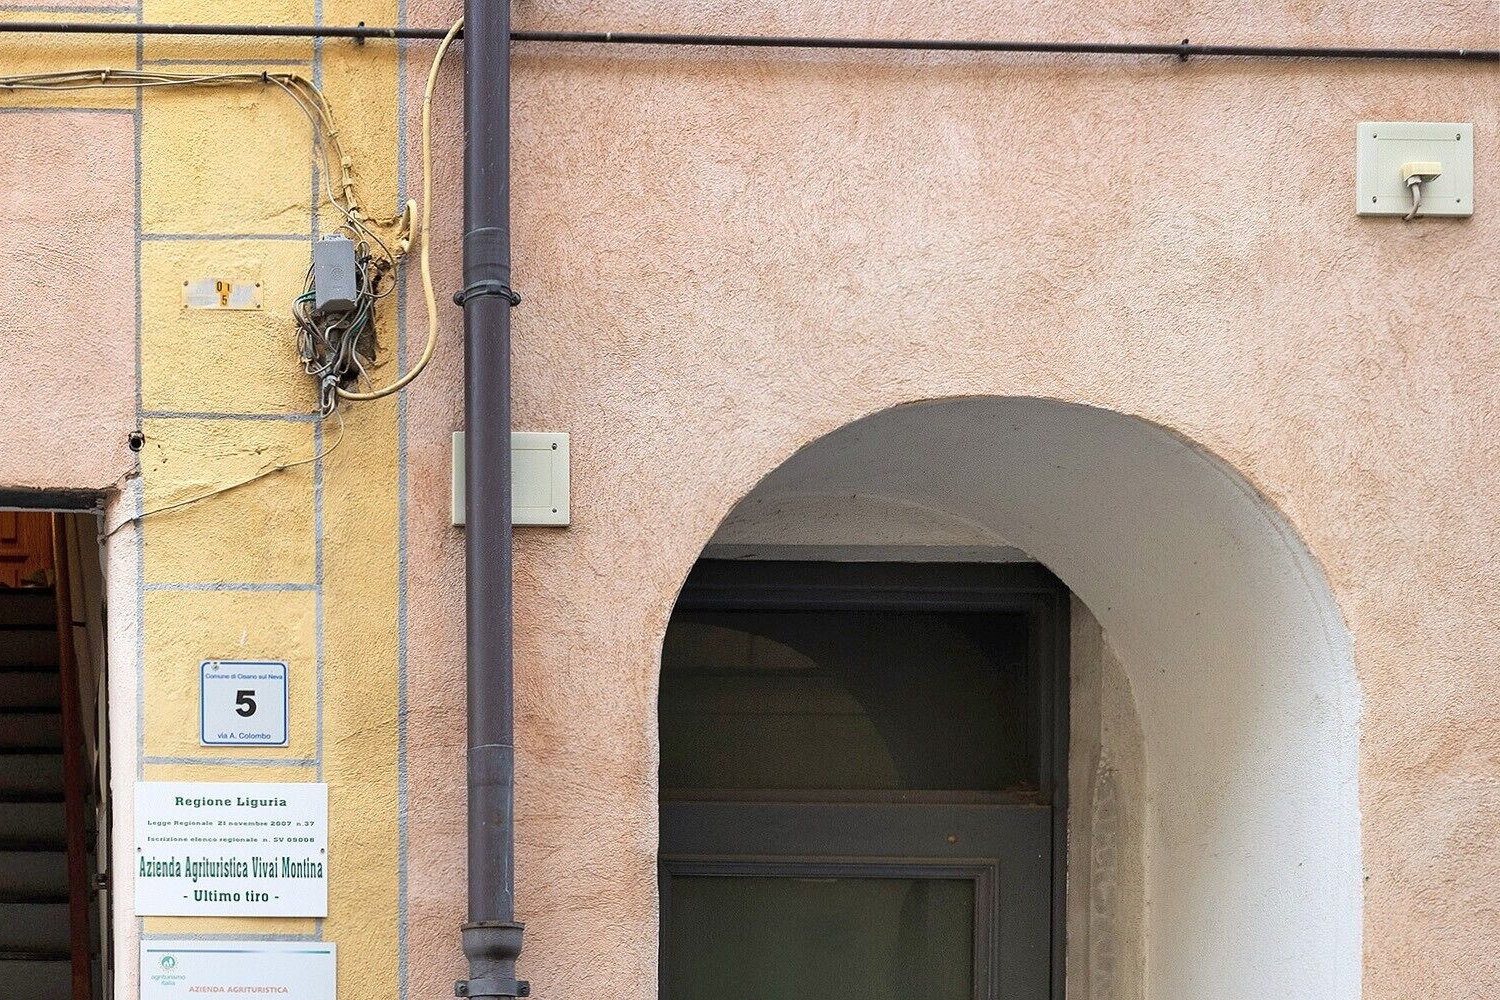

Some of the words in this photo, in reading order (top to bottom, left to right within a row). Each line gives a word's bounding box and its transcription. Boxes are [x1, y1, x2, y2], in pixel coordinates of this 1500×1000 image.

[235, 689, 257, 718] 5
[175, 796, 232, 808] Regione
[236, 797, 287, 809] Liguria
[219, 836, 258, 844] regionale
[139, 856, 182, 878] Azienda
[184, 856, 249, 883] Agrituristica
[252, 856, 278, 879] Vivai
[281, 857, 323, 879] Montina
[194, 889, 241, 902] Ultimo
[245, 890, 269, 902] tiro
[227, 986, 288, 994] AGRITURISTICA
